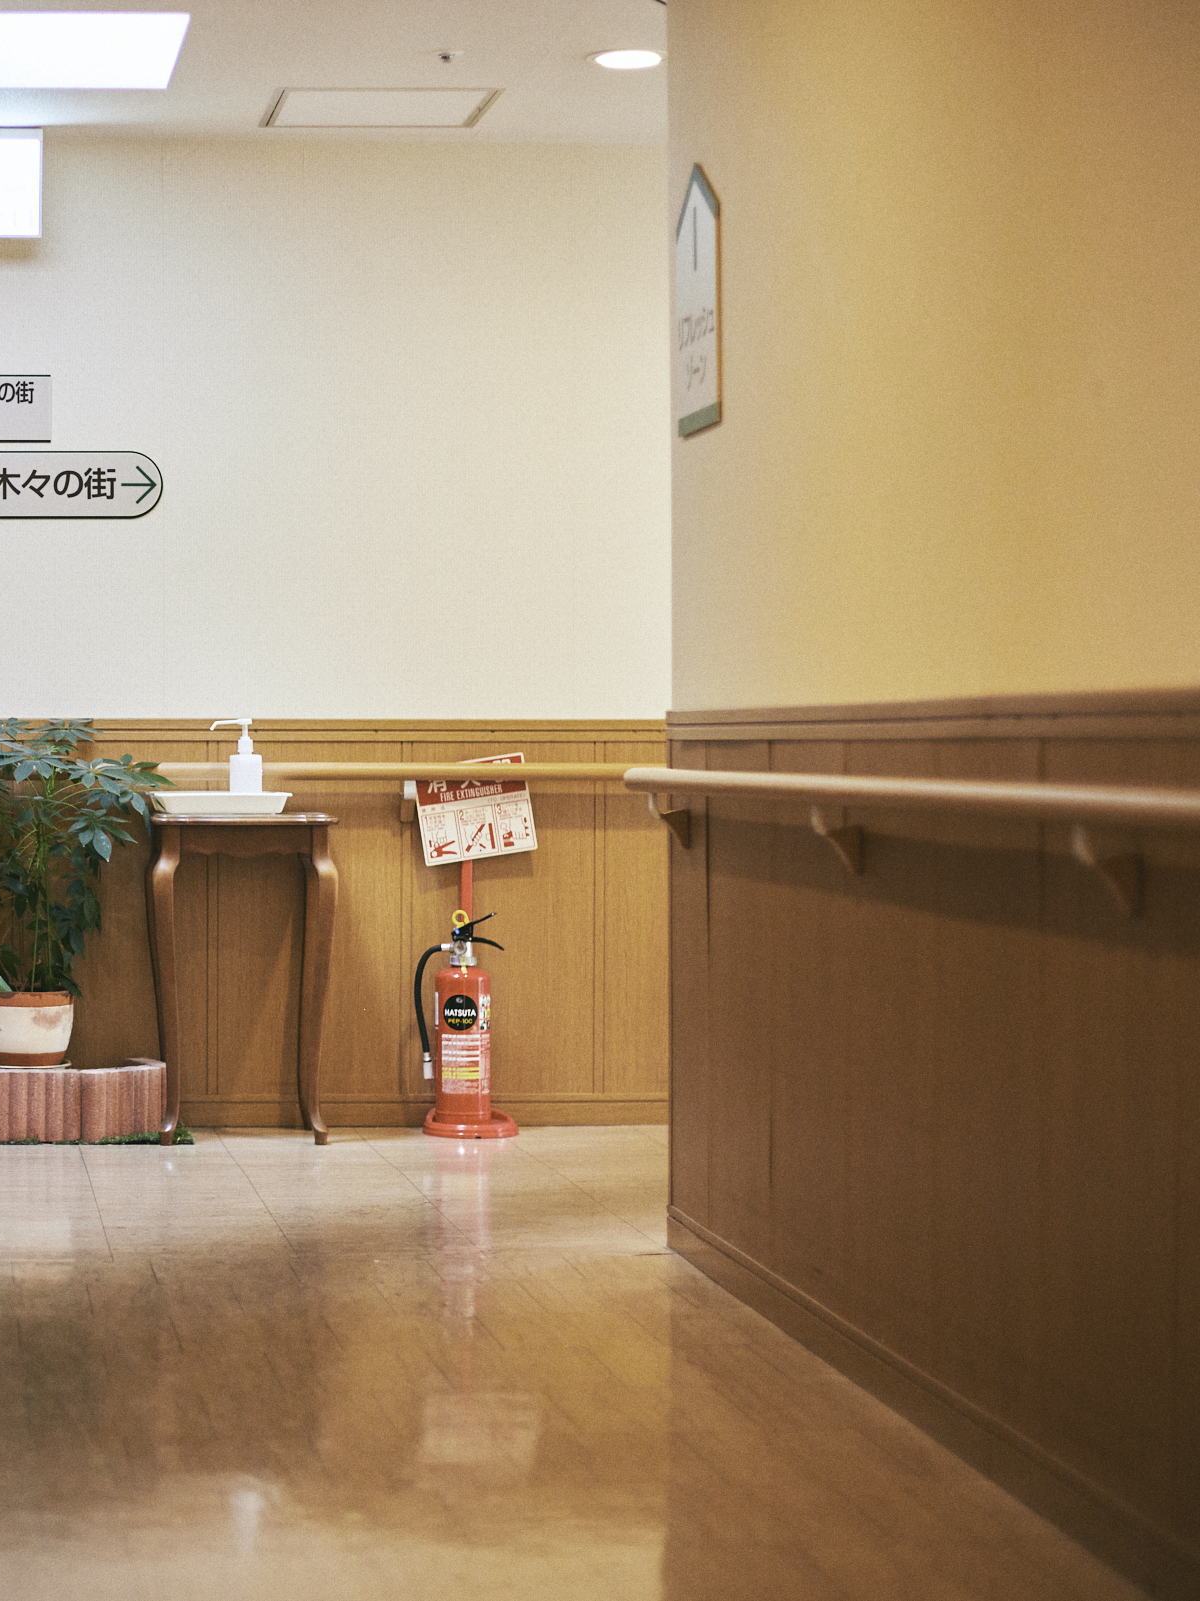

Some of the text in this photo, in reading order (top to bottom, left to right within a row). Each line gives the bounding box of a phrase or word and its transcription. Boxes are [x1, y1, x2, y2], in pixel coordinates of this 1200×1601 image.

[440, 792, 455, 803] FIRE
[456, 784, 503, 800] EXTINGUISHER
[496, 803, 502, 815] 3
[459, 810, 465, 821] 2
[444, 1008, 476, 1017] HATSUTA
